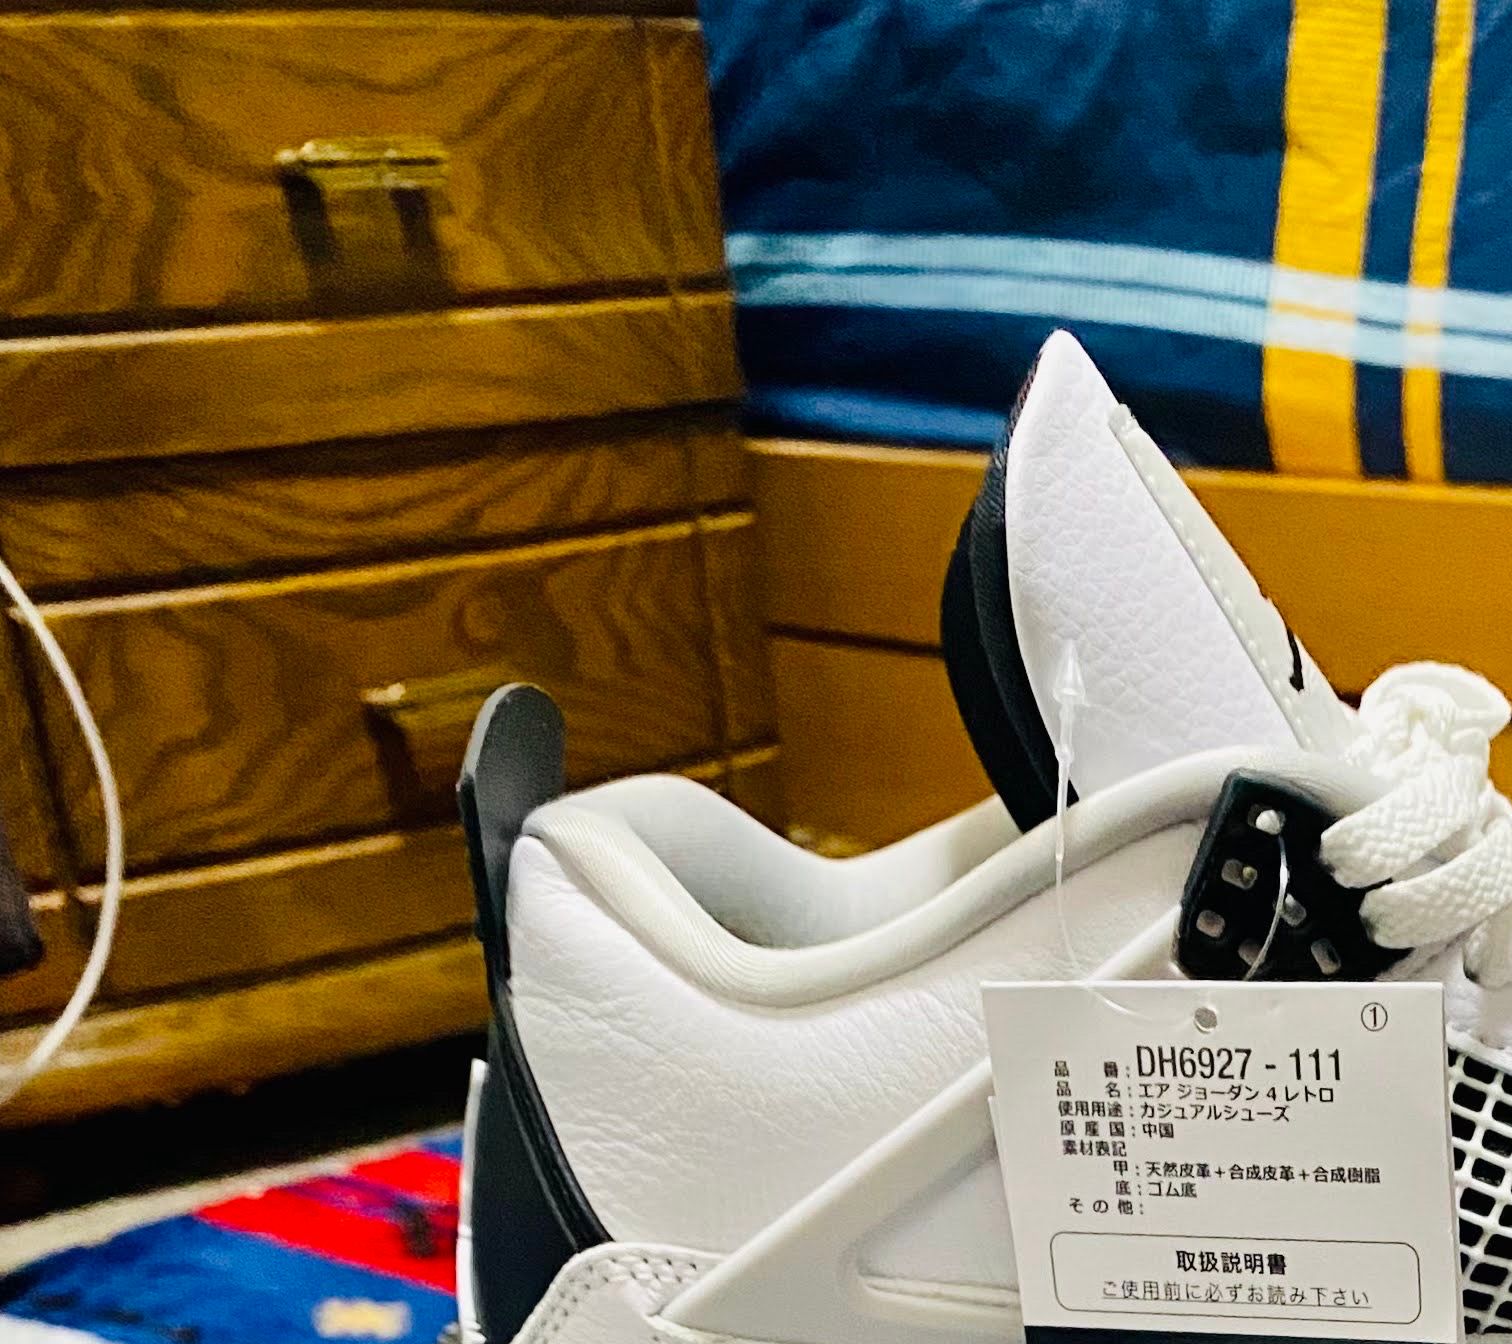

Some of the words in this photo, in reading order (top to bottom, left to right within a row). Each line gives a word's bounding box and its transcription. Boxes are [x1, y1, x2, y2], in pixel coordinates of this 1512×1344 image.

[1135, 1044, 1253, 1081] DH6927
[1288, 1047, 1341, 1082] 111
[1056, 1080, 1072, 1098] 品
[1138, 1083, 1171, 1099] エア
[1176, 1083, 1260, 1102] ジョーダン
[1265, 1086, 1277, 1102] 4
[1284, 1084, 1335, 1103] レトロ
[1140, 1102, 1290, 1123] カジュアルシューズ
[1141, 1121, 1175, 1140] 中国
[1062, 1138, 1128, 1158] 素材表記
[1147, 1180, 1198, 1199] ゴム底
[1175, 1249, 1288, 1276] 取扱説明書
[1103, 1279, 1369, 1307] ご使用前に必ずお読み下さい
